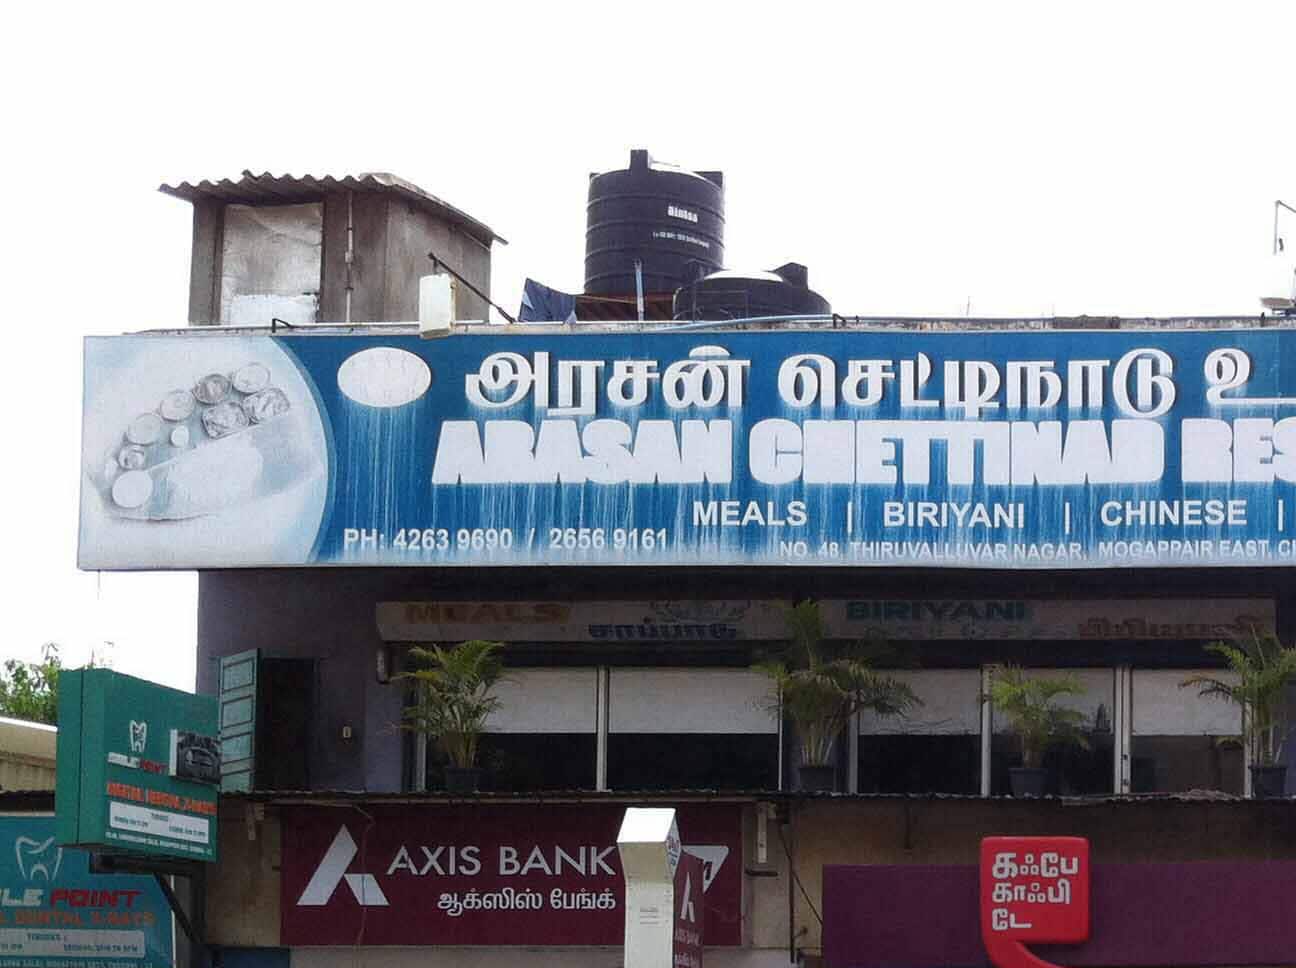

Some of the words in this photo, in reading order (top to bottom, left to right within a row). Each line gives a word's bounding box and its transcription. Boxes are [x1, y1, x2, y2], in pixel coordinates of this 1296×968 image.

[465, 345, 751, 416] அரசன்
[778, 347, 1177, 418] செட்டிநாடு
[432, 419, 733, 485] ARASAN
[748, 418, 1166, 485] CHETTINAD
[692, 500, 808, 528] MEALS
[883, 501, 1025, 529] BIRIYANI
[1101, 499, 1248, 527] CHINESE
[344, 528, 385, 551] PH:
[393, 528, 449, 550] 4263
[457, 528, 513, 550] 9690
[549, 528, 605, 550] 2656
[613, 528, 668, 550] 9161
[1099, 539, 1212, 559] MOGAPPAIR
[386, 845, 482, 876] AXIS
[499, 845, 617, 876] BANK
[992, 852, 1079, 879] கஃபே
[51, 889, 143, 907] POINT
[437, 887, 543, 917] ஆக்ஸிஸ்
[992, 878, 1071, 904] காஃபி
[992, 908, 1032, 931] டே
